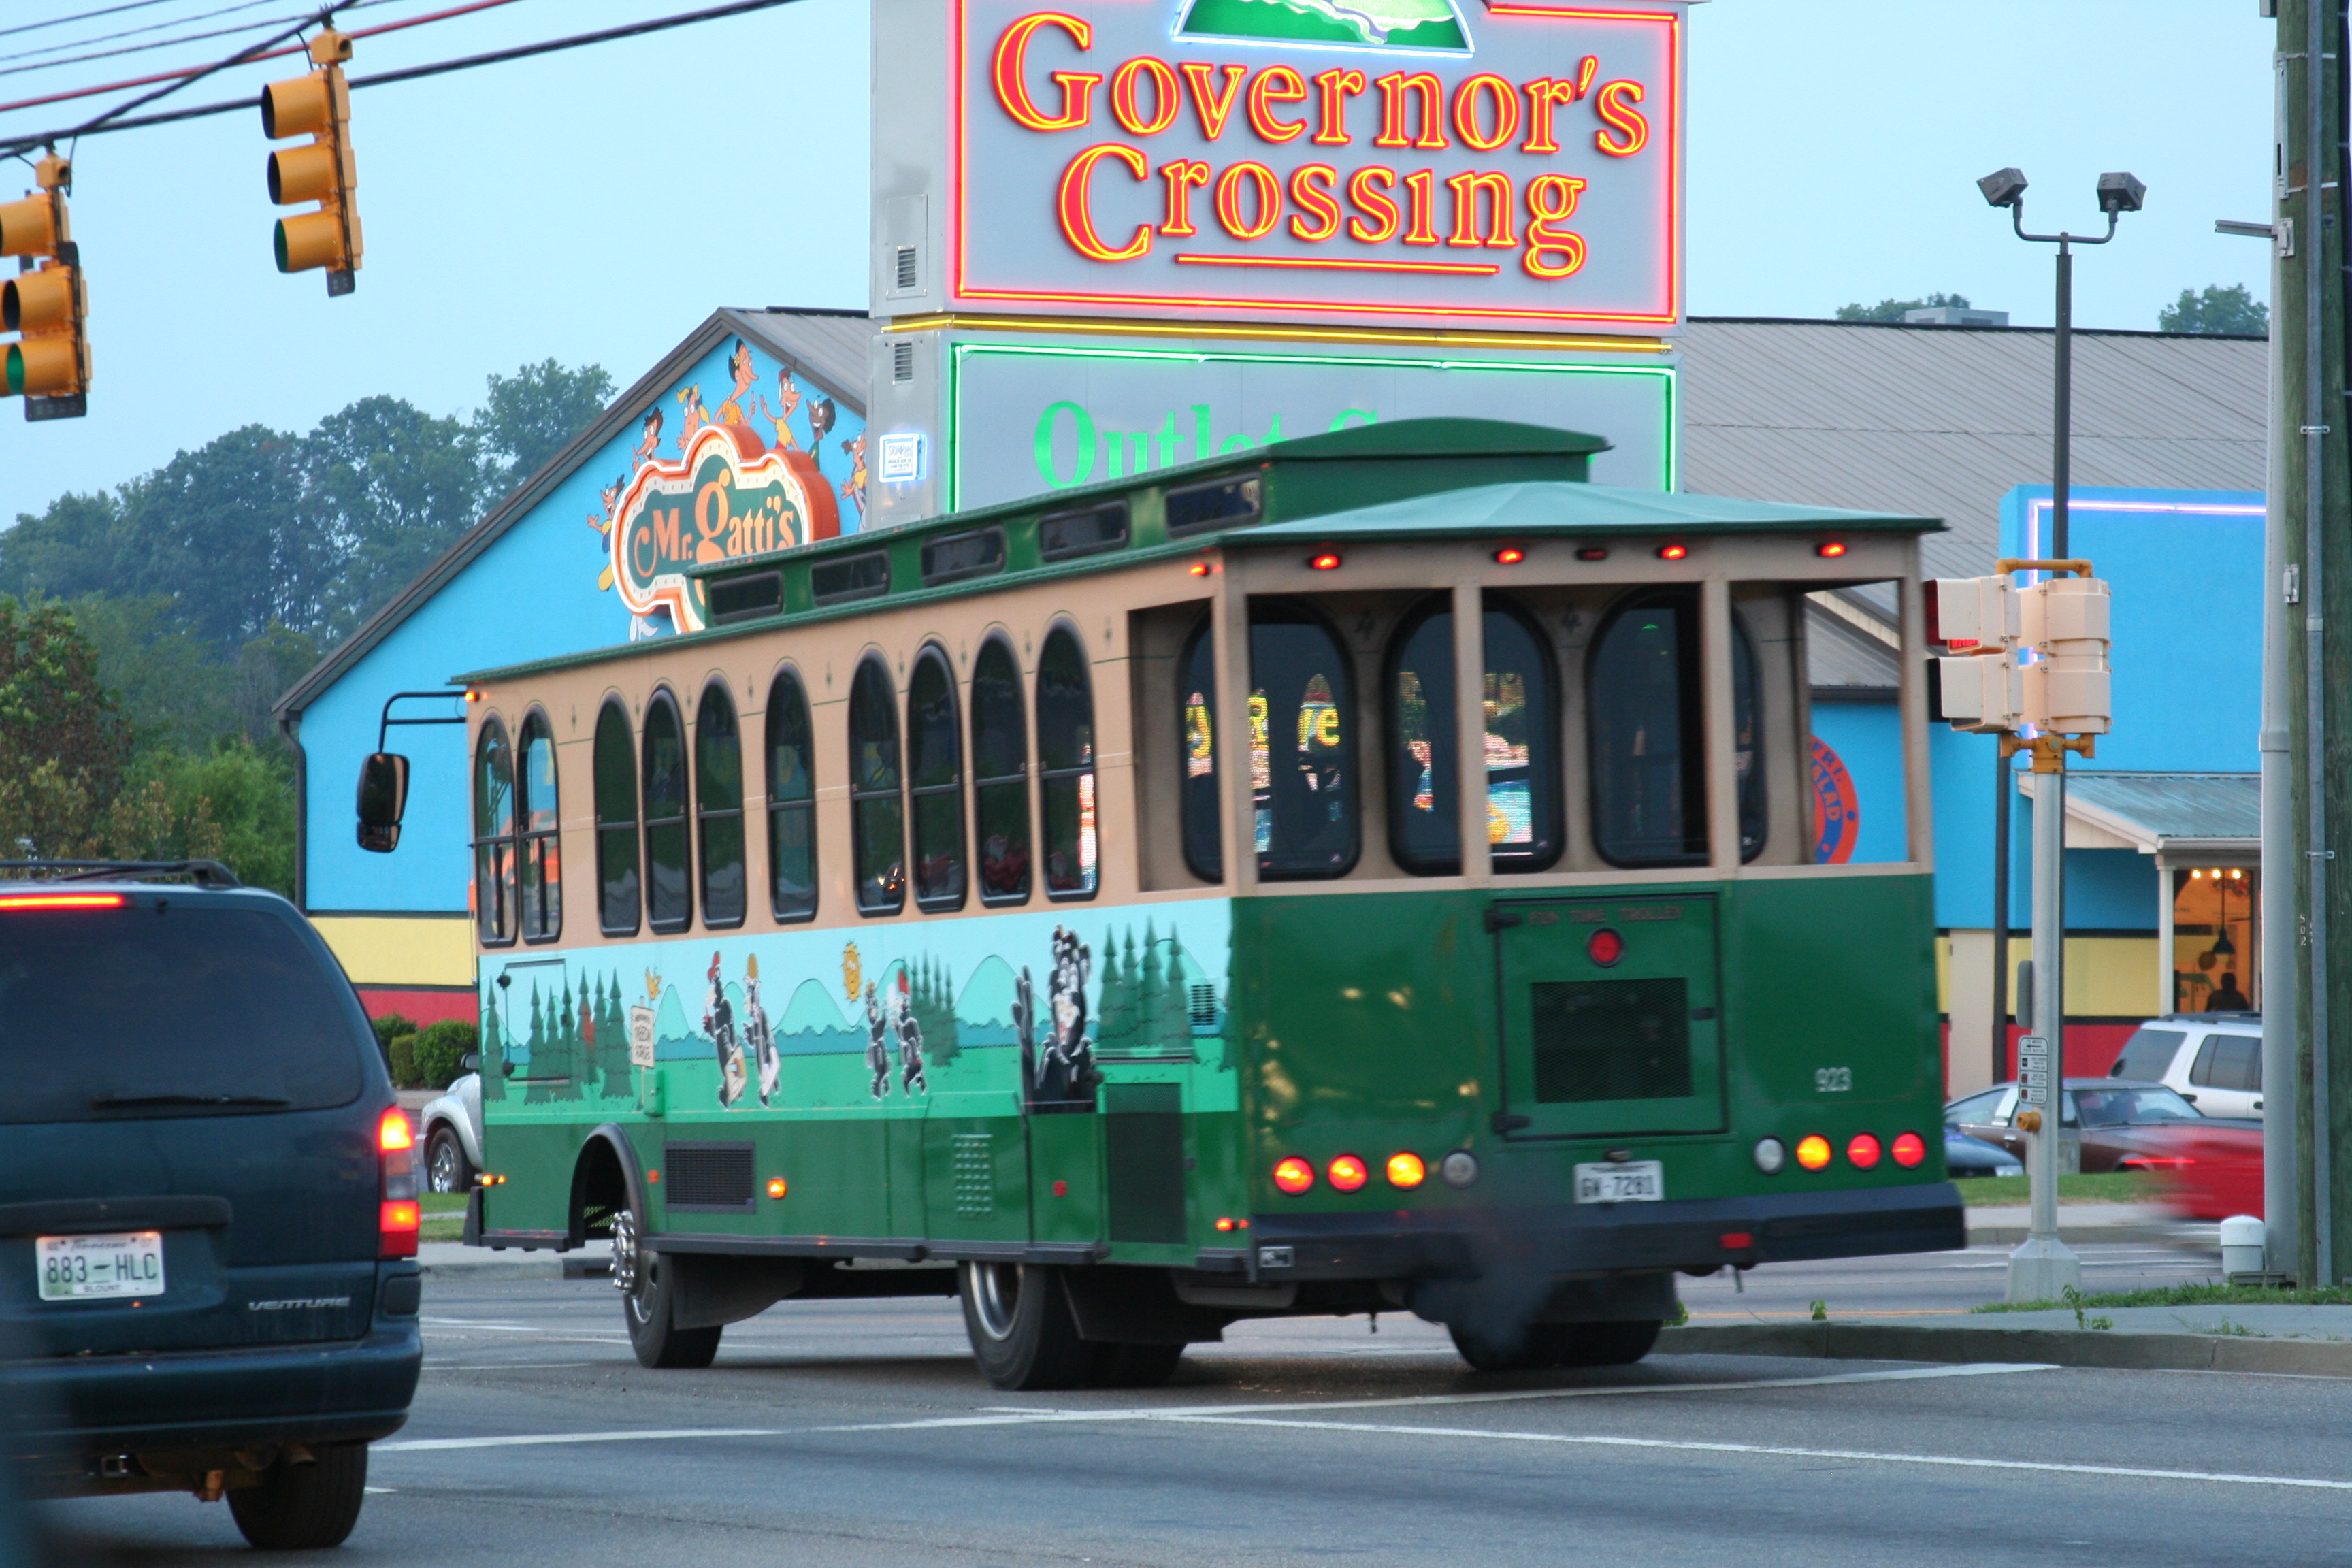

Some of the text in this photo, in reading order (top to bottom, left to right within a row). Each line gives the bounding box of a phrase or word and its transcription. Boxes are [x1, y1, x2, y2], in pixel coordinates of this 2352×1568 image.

[992, 10, 1651, 159] Governor's
[1057, 142, 1588, 280] Crossing
[634, 508, 694, 578] Mr.
[1814, 1066, 1852, 1093] 923
[248, 1296, 351, 1311] VENTURE
